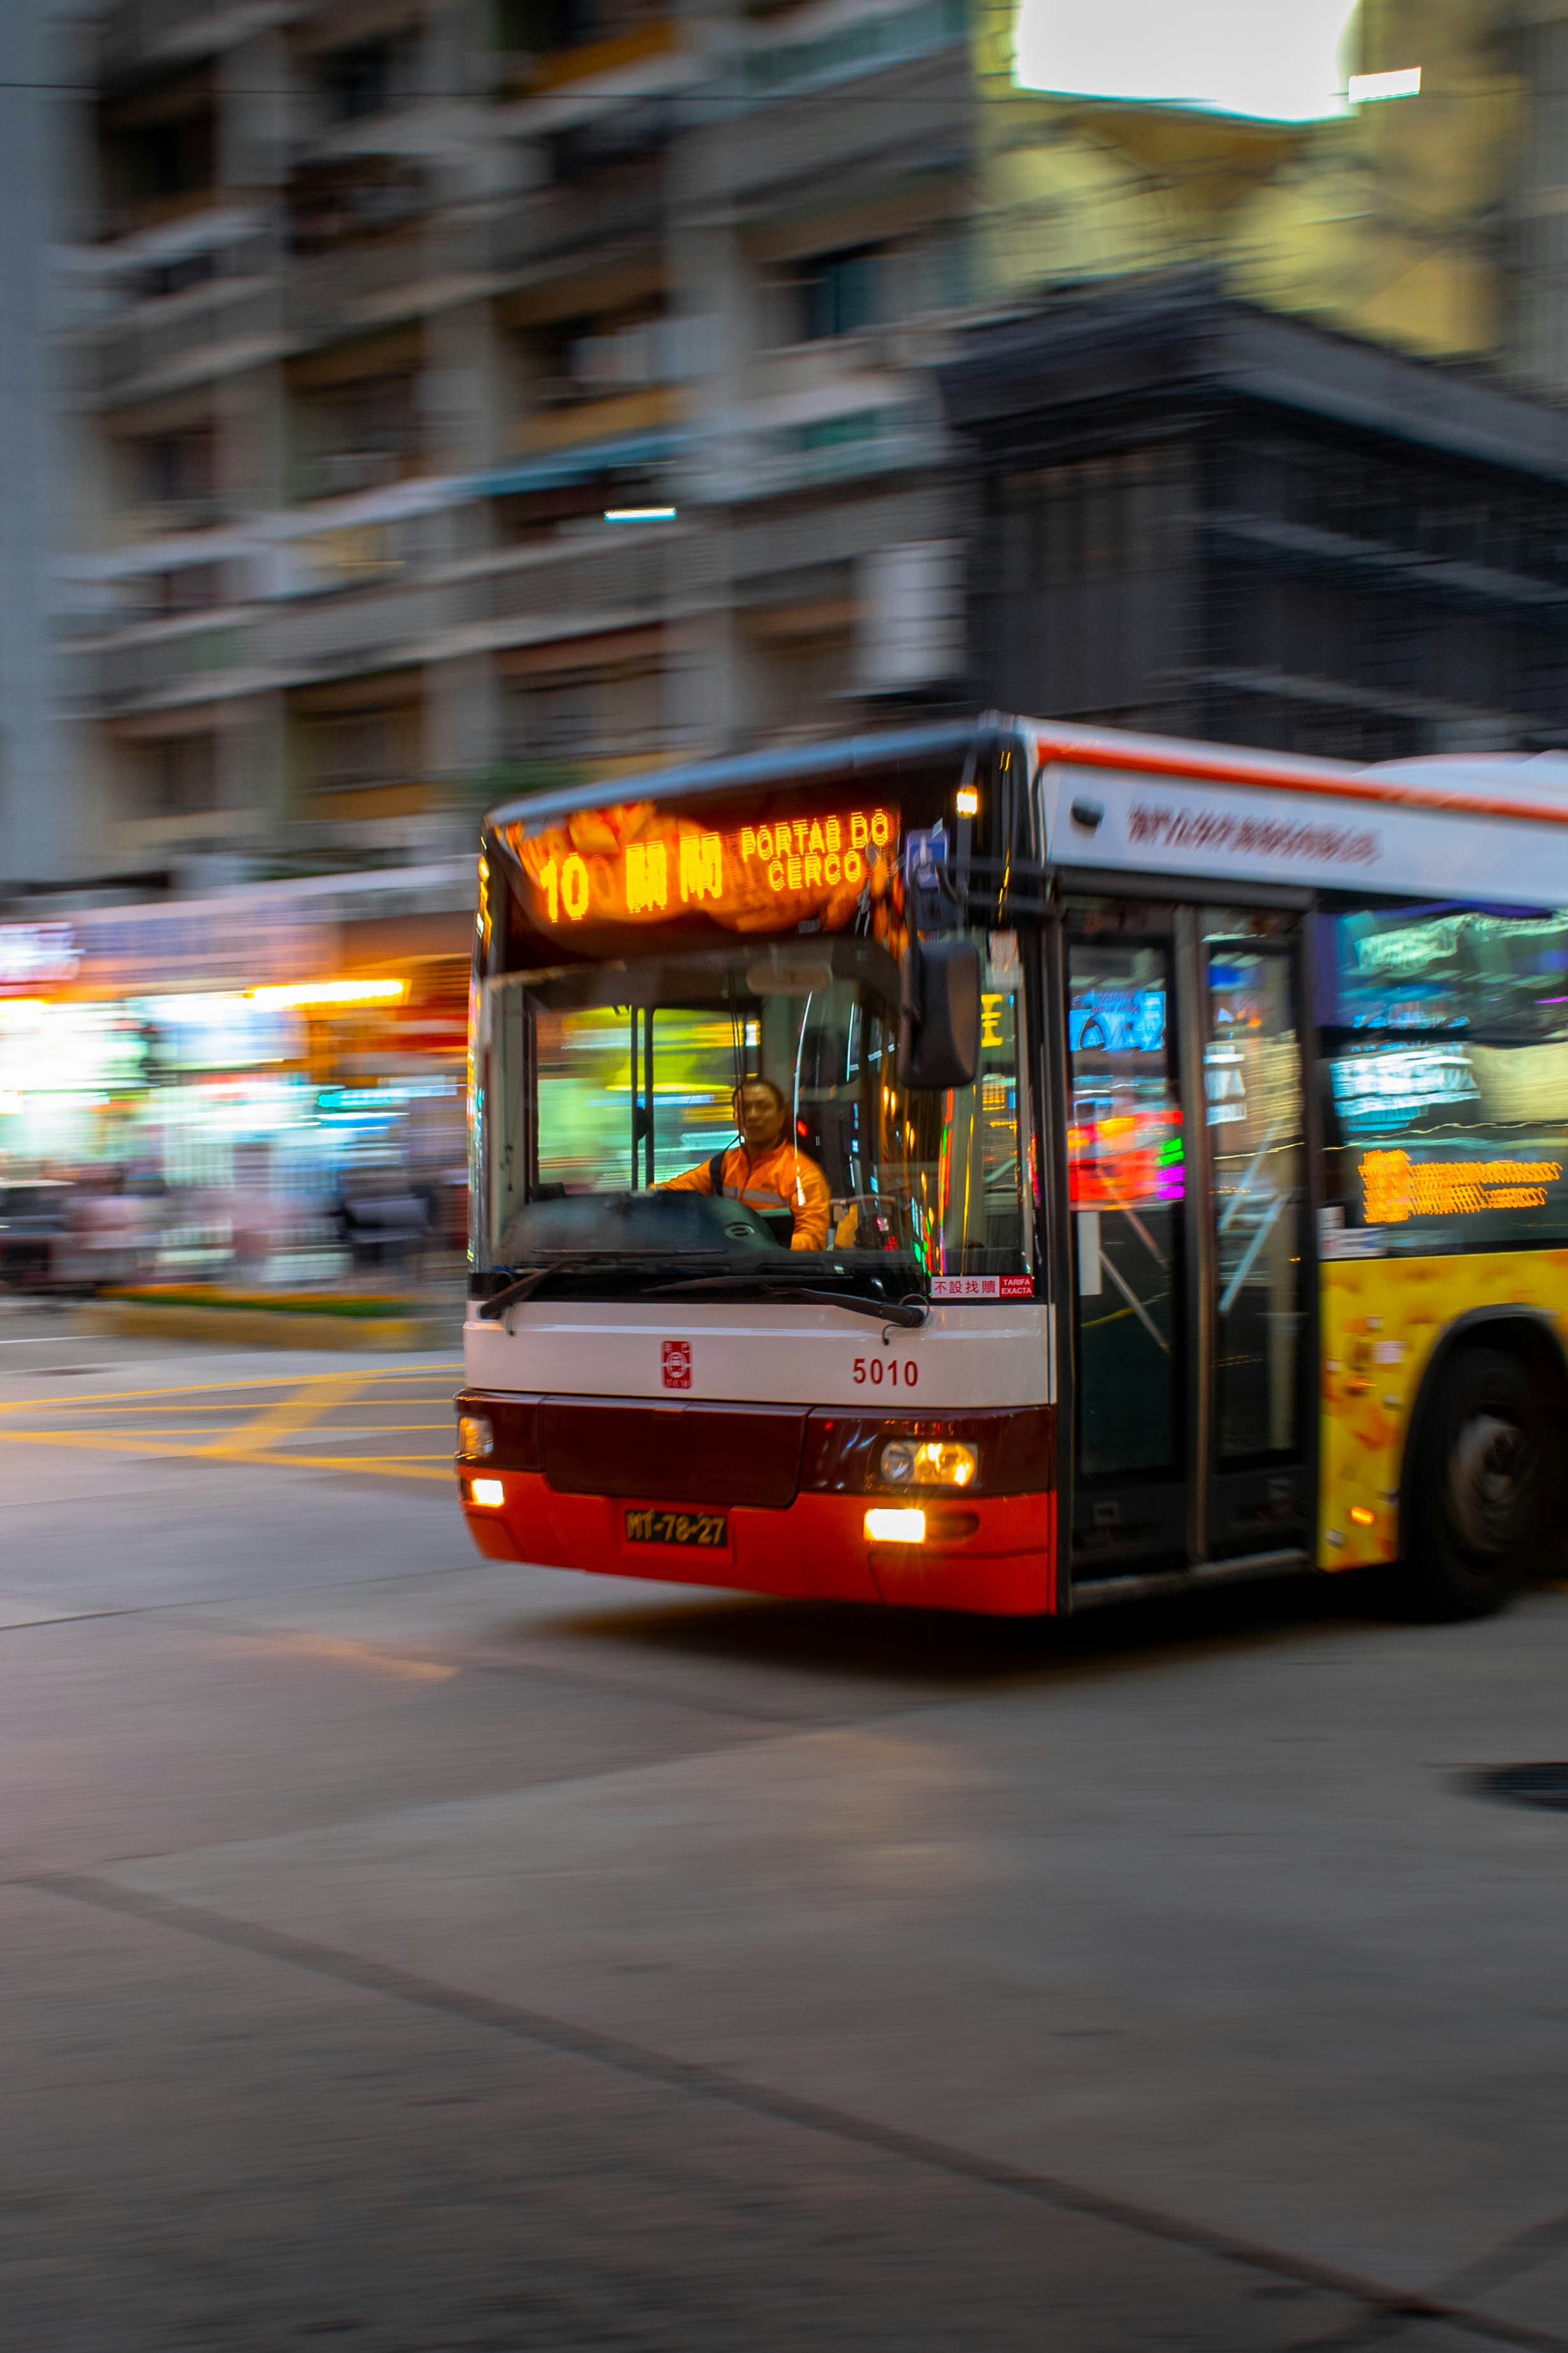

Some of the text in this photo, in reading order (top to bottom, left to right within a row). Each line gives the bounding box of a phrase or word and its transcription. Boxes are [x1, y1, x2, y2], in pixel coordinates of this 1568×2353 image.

[851, 809, 889, 849] DO
[539, 852, 589, 923] 10
[768, 847, 861, 891] CERCO
[1001, 1287, 1032, 1295] EXACTA
[852, 1358, 918, 1387] 5010
